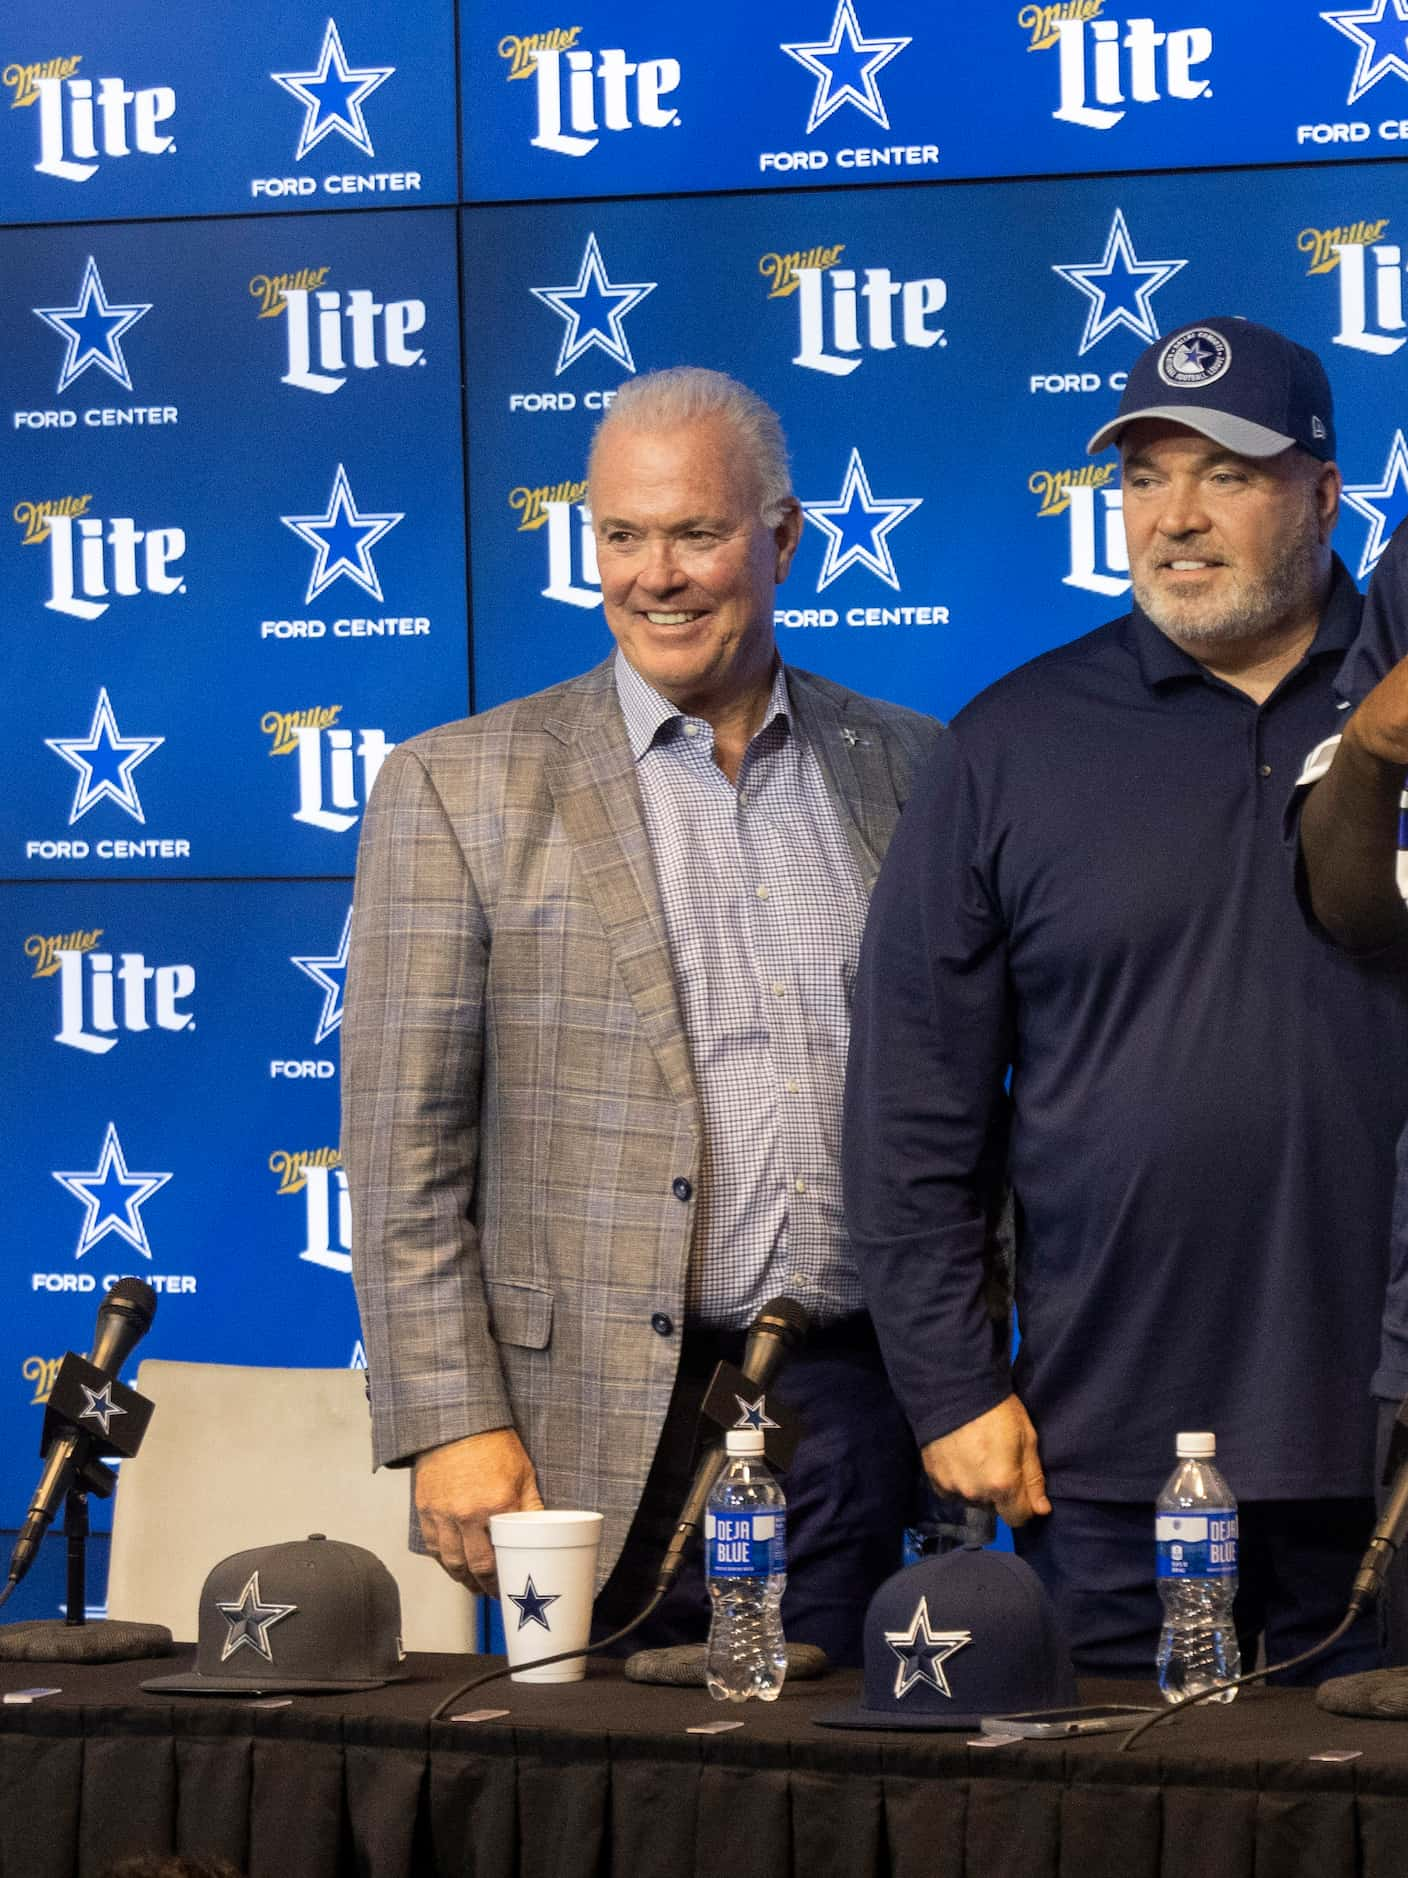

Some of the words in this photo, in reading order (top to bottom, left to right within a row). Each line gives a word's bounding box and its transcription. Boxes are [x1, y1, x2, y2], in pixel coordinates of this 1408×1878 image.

[499, 27, 582, 80] Miller
[1050, 17, 1212, 129] Lite
[3, 56, 82, 108] Miller
[529, 48, 681, 156] Lite
[33, 77, 177, 181] Lite
[1298, 123, 1370, 144] FORD
[760, 151, 828, 171] FORD
[837, 146, 938, 167] CENTER
[252, 178, 316, 196] FORD
[324, 172, 420, 193] CENTER
[759, 245, 845, 298] Miller
[1298, 220, 1389, 274] Miller
[249, 267, 330, 318] Miller
[279, 290, 426, 393] Lite
[791, 268, 947, 375] Lite
[510, 393, 576, 411] FORD
[1031, 374, 1100, 392] FORD
[14, 411, 76, 428] FORD
[85, 407, 177, 425] CENTER
[1029, 463, 1117, 515] Miller
[13, 495, 92, 544] Miller
[1061, 486, 1133, 596] Li
[44, 516, 187, 620] Lite
[541, 502, 604, 608] Li
[262, 621, 326, 638] FORD
[334, 618, 430, 636] CENTER
[774, 610, 838, 627] FORD
[847, 607, 949, 626] CENTER
[261, 705, 342, 755] Miller
[291, 727, 395, 832] Lit
[27, 841, 89, 858] FORD
[97, 840, 189, 858] CENTER
[25, 929, 103, 979] Miller
[54, 950, 195, 1053] Lite
[271, 1061, 334, 1078] FORD
[270, 1147, 341, 1194] Mille
[32, 1274, 95, 1291] FORD
[103, 1275, 196, 1292] CTER
[718, 1521, 750, 1541] DEJA
[718, 1542, 750, 1562] BLUE
[1210, 1542, 1236, 1563] BLUE
